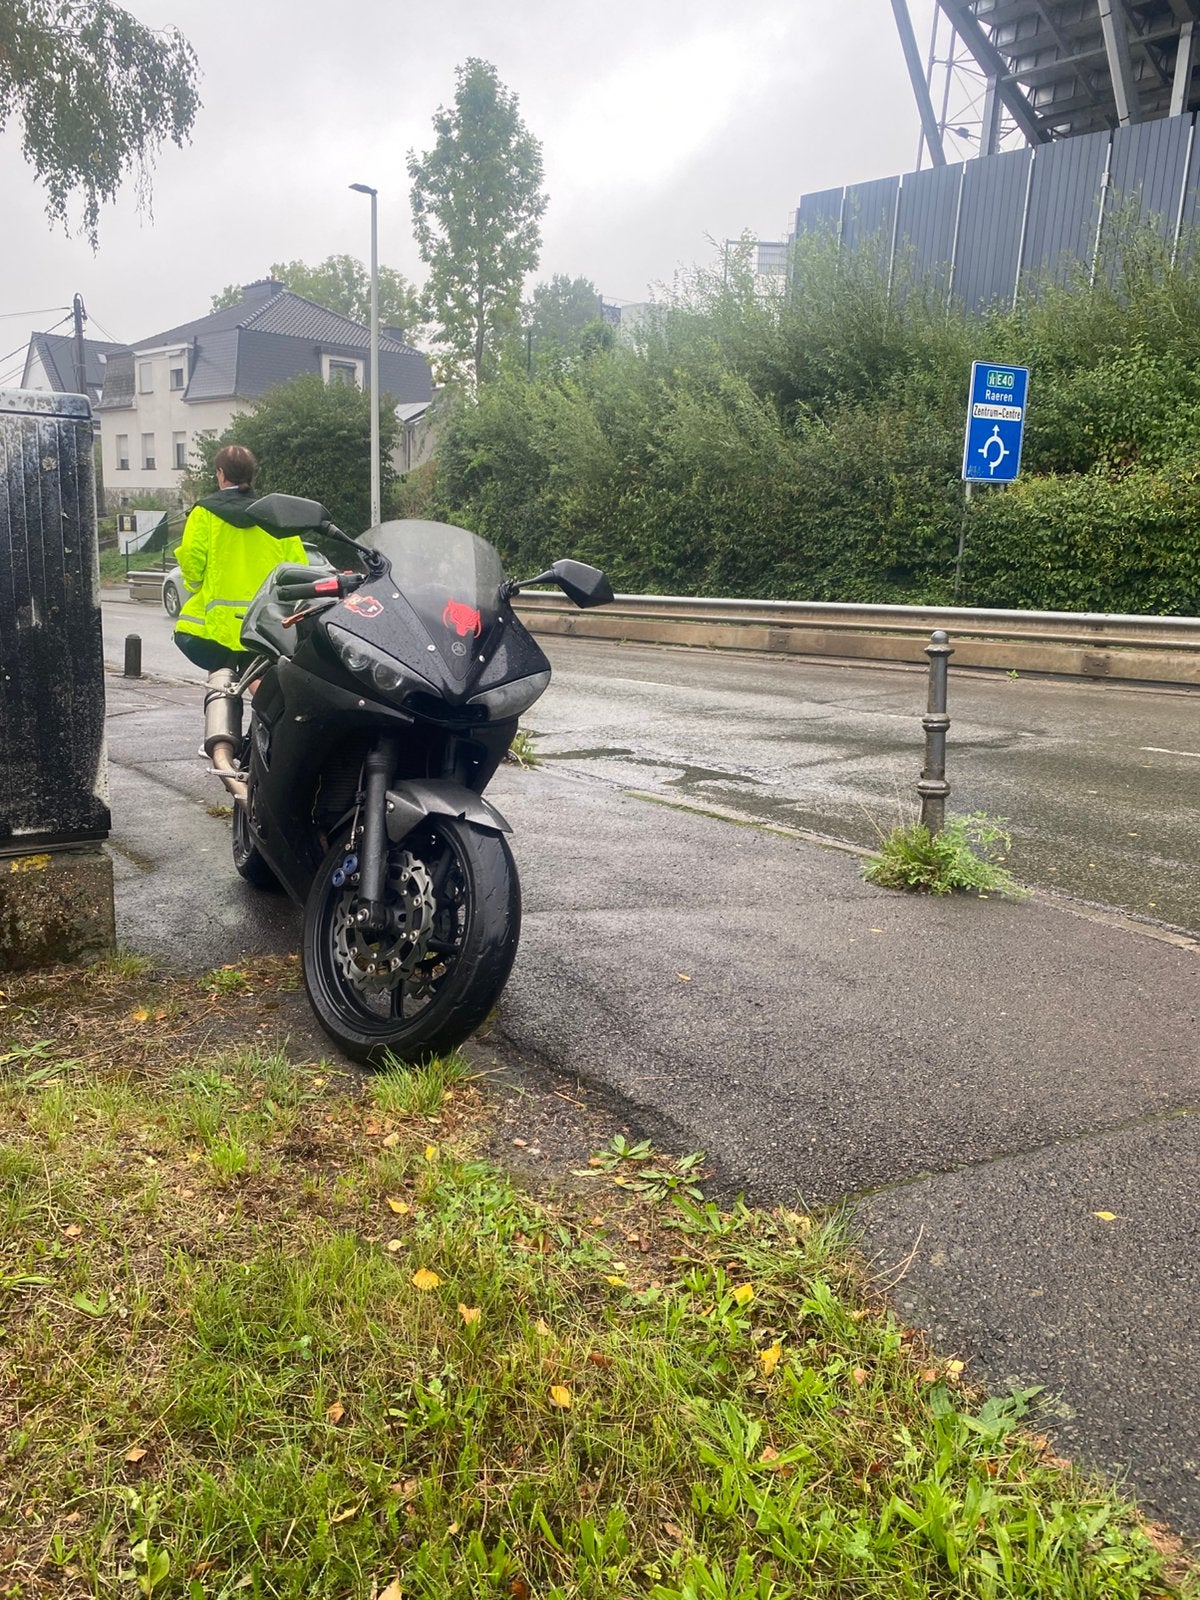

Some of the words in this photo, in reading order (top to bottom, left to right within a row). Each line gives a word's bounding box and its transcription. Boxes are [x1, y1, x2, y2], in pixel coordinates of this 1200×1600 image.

[997, 374, 1013, 387] E40
[985, 389, 1013, 402] Raeren
[974, 404, 1020, 420] Zentrum-Centre
